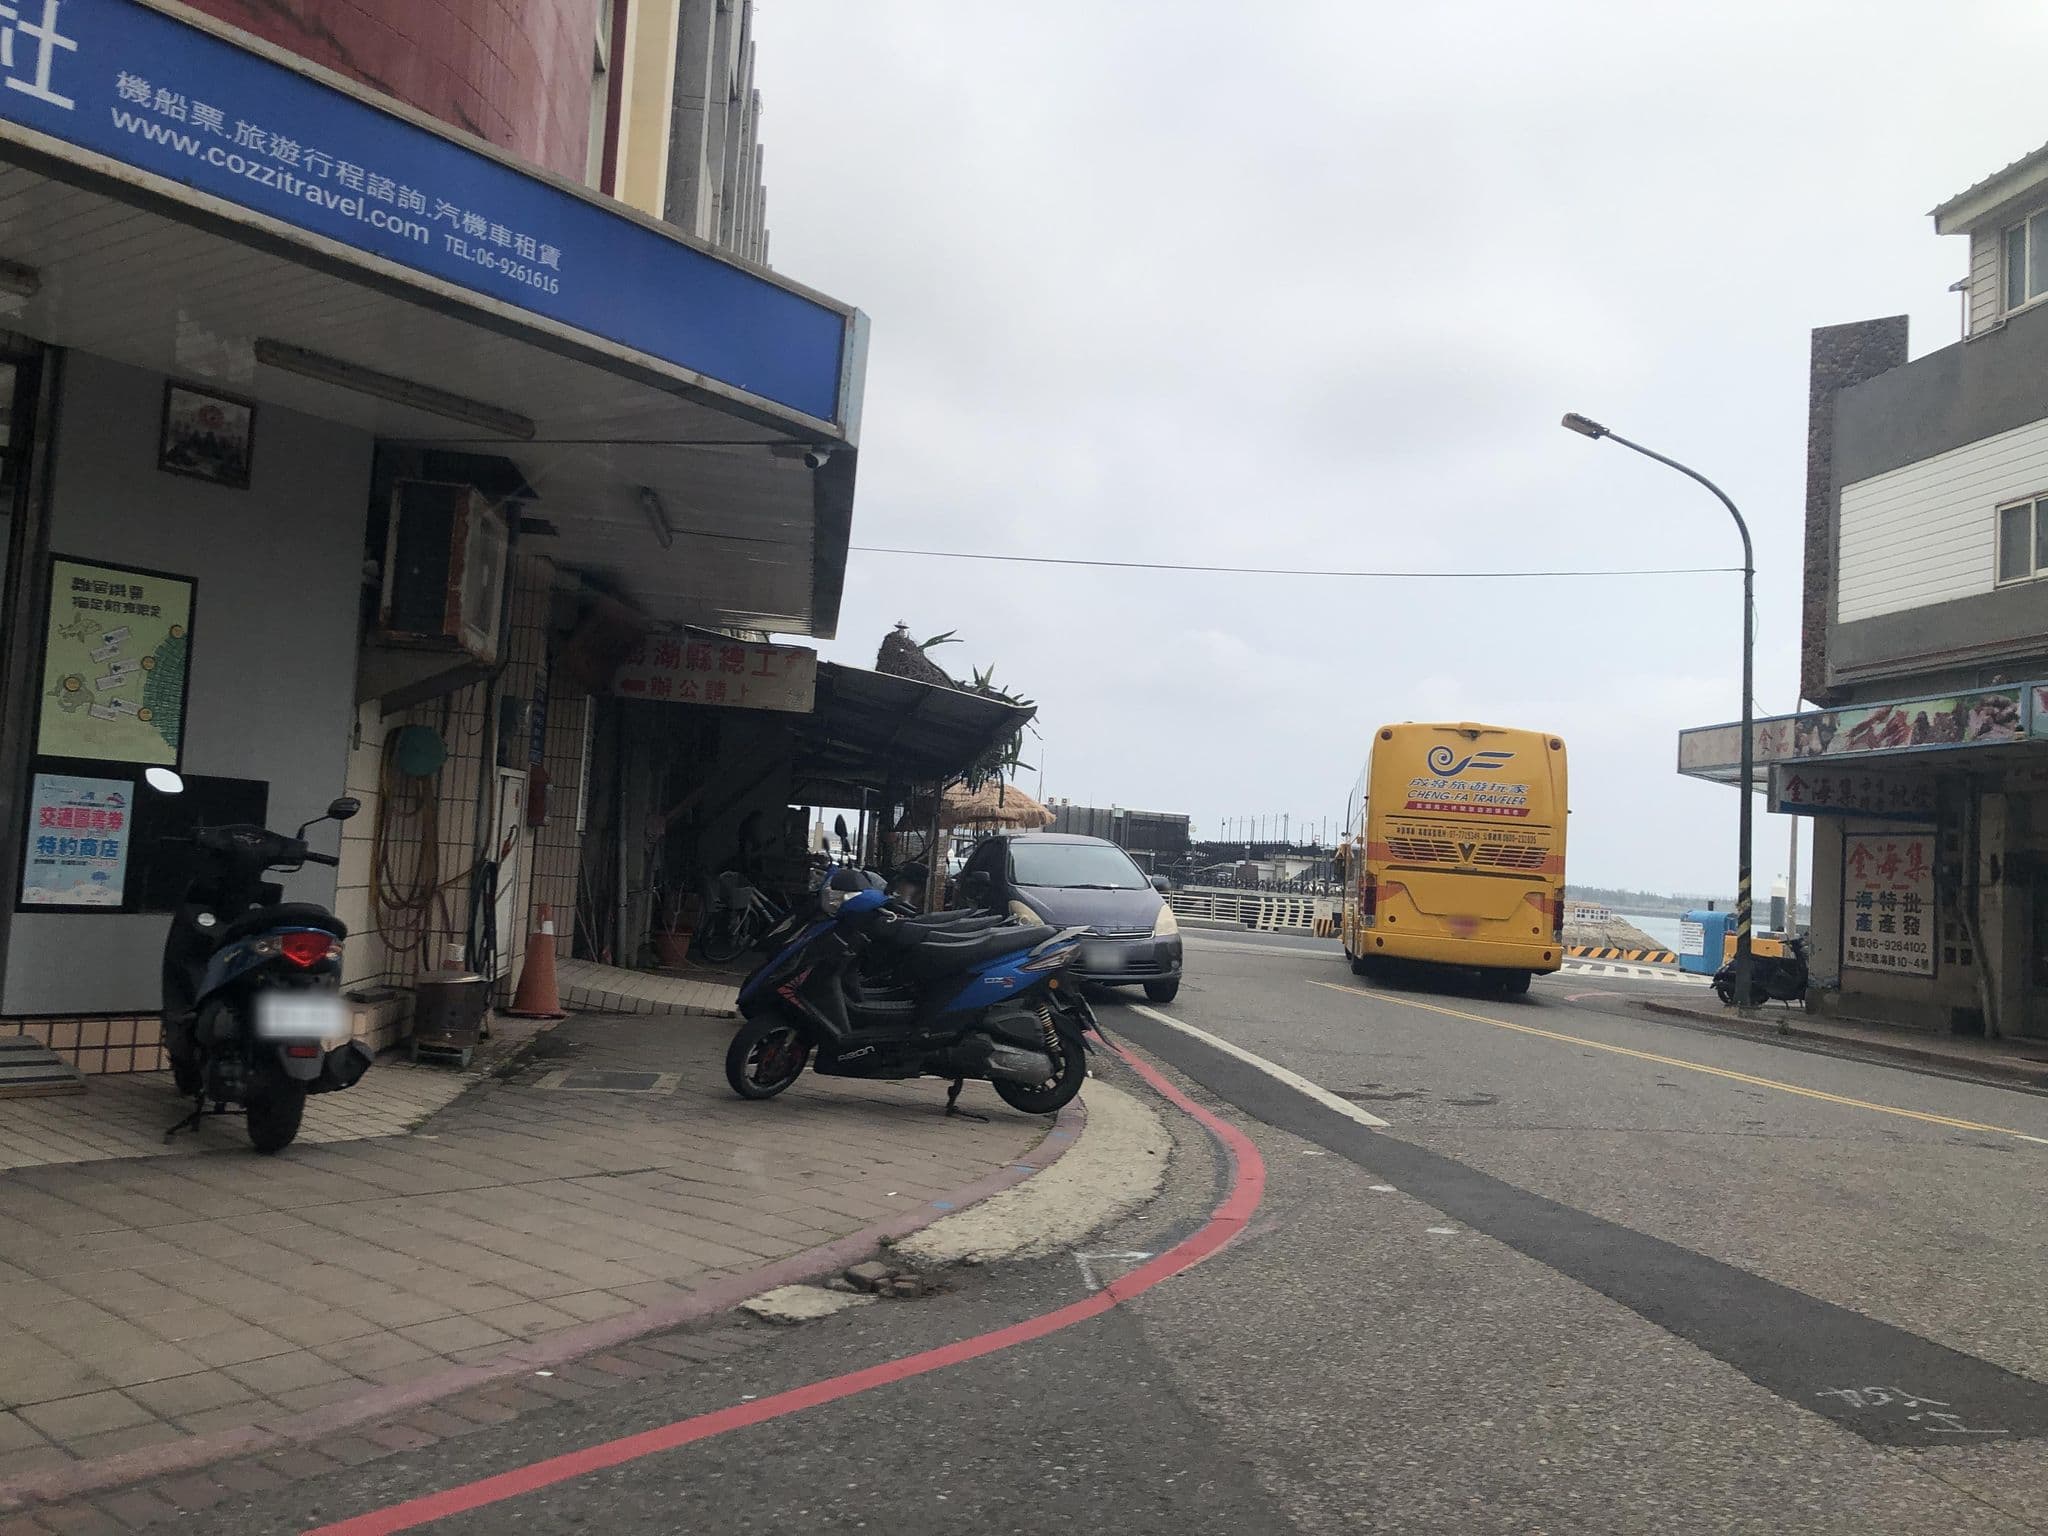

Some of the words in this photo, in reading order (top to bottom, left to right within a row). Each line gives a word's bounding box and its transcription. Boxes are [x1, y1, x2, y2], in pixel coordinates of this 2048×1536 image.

[110, 106, 429, 244] www.cozzitravel.com
[444, 235, 559, 295] TEL:06-9261616
[1407, 789, 1468, 802] CHENG-FA
[1473, 793, 1527, 805] TRAVELER
[37, 835, 119, 858] 特約商店
[1849, 841, 1930, 882] 金海集
